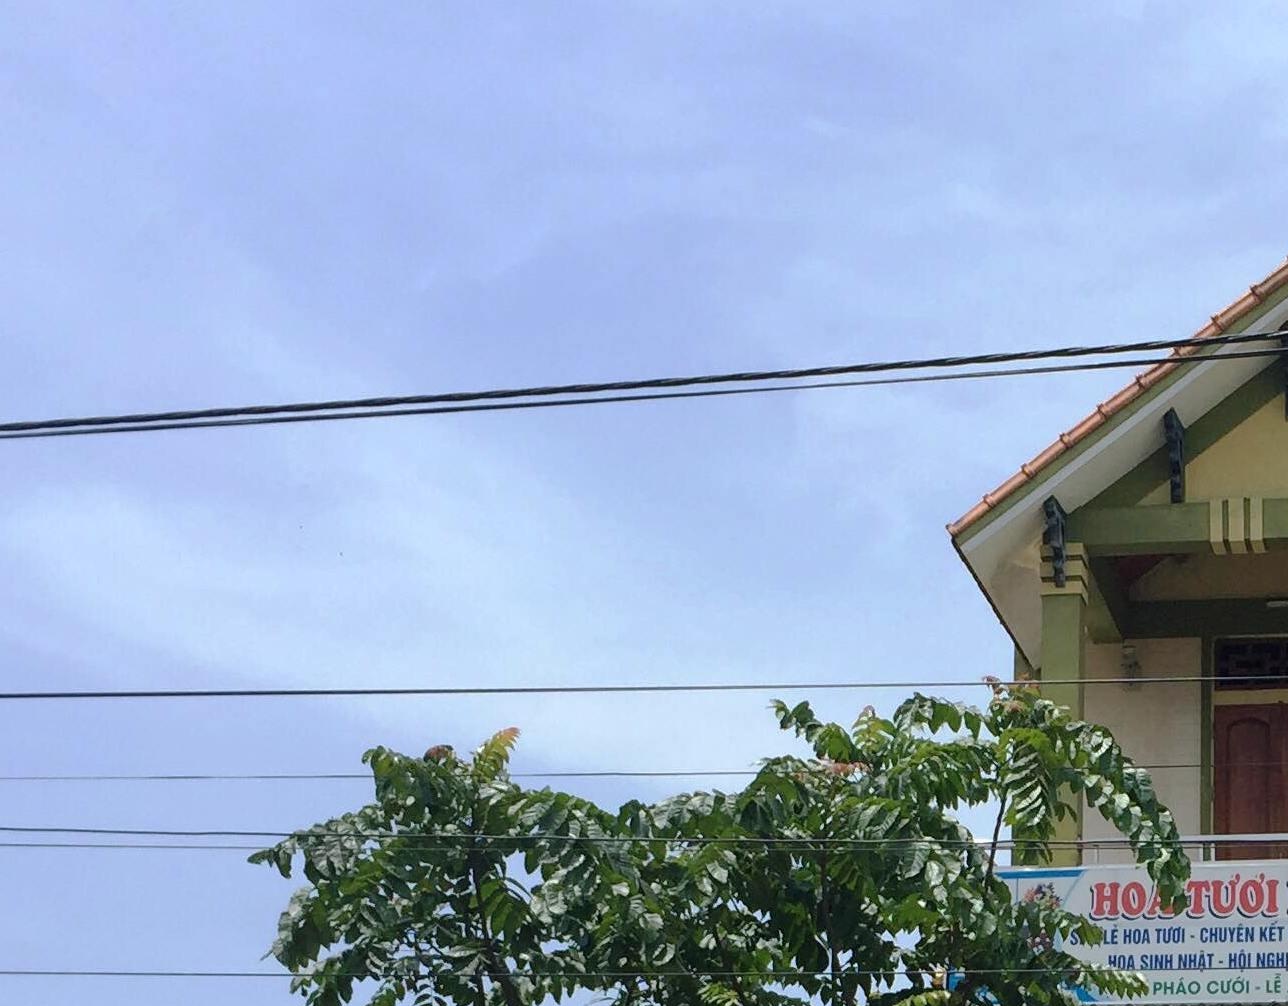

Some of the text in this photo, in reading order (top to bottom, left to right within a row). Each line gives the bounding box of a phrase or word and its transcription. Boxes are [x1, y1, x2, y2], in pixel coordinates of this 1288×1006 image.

[1187, 872, 1280, 918] TƯƠI
[1123, 928, 1151, 945] HOA
[1154, 926, 1185, 944] TƯƠI
[1200, 923, 1255, 943] CHUYÊN
[1259, 920, 1285, 943] KẾT
[1108, 954, 1136, 970] HOA
[1140, 954, 1173, 971] SINH
[1178, 950, 1214, 973] NHẬT
[1228, 949, 1252, 973] HỘI
[1152, 977, 1201, 995] PHÁO
[1206, 976, 1250, 994] CƯỚI
[1266, 973, 1282, 993] LỄ
